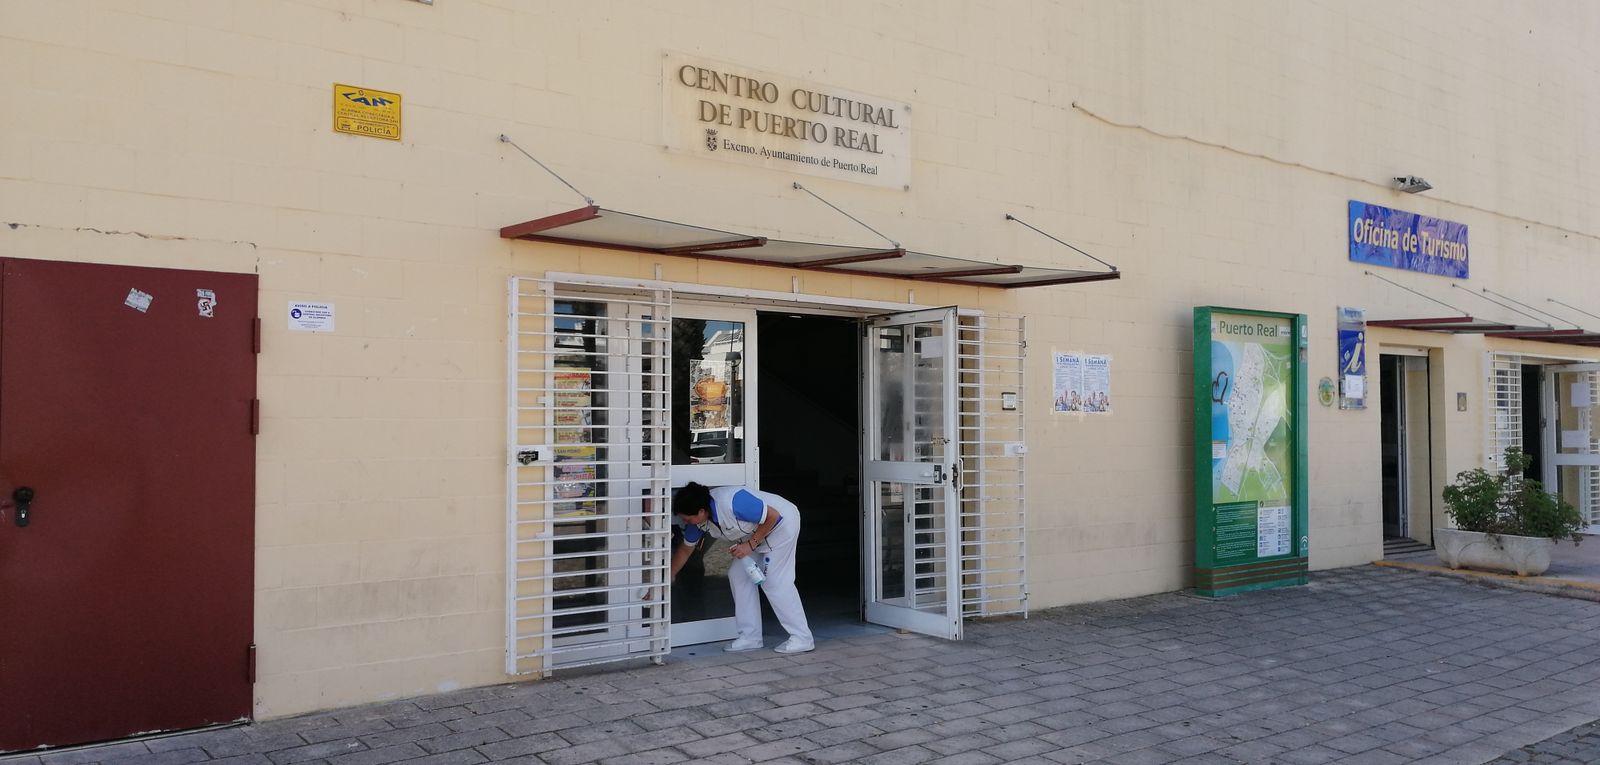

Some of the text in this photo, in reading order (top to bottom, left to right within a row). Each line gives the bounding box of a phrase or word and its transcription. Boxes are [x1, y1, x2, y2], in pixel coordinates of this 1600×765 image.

[679, 65, 899, 129] CENTRO CULTURAL
[699, 100, 884, 154] DE PUERTO REAL
[723, 138, 878, 176] Excmo. Ayuntamiento de Puerto Real
[1353, 217, 1466, 261] Oficina de Turismo
[1219, 320, 1278, 337] Puerto Real
